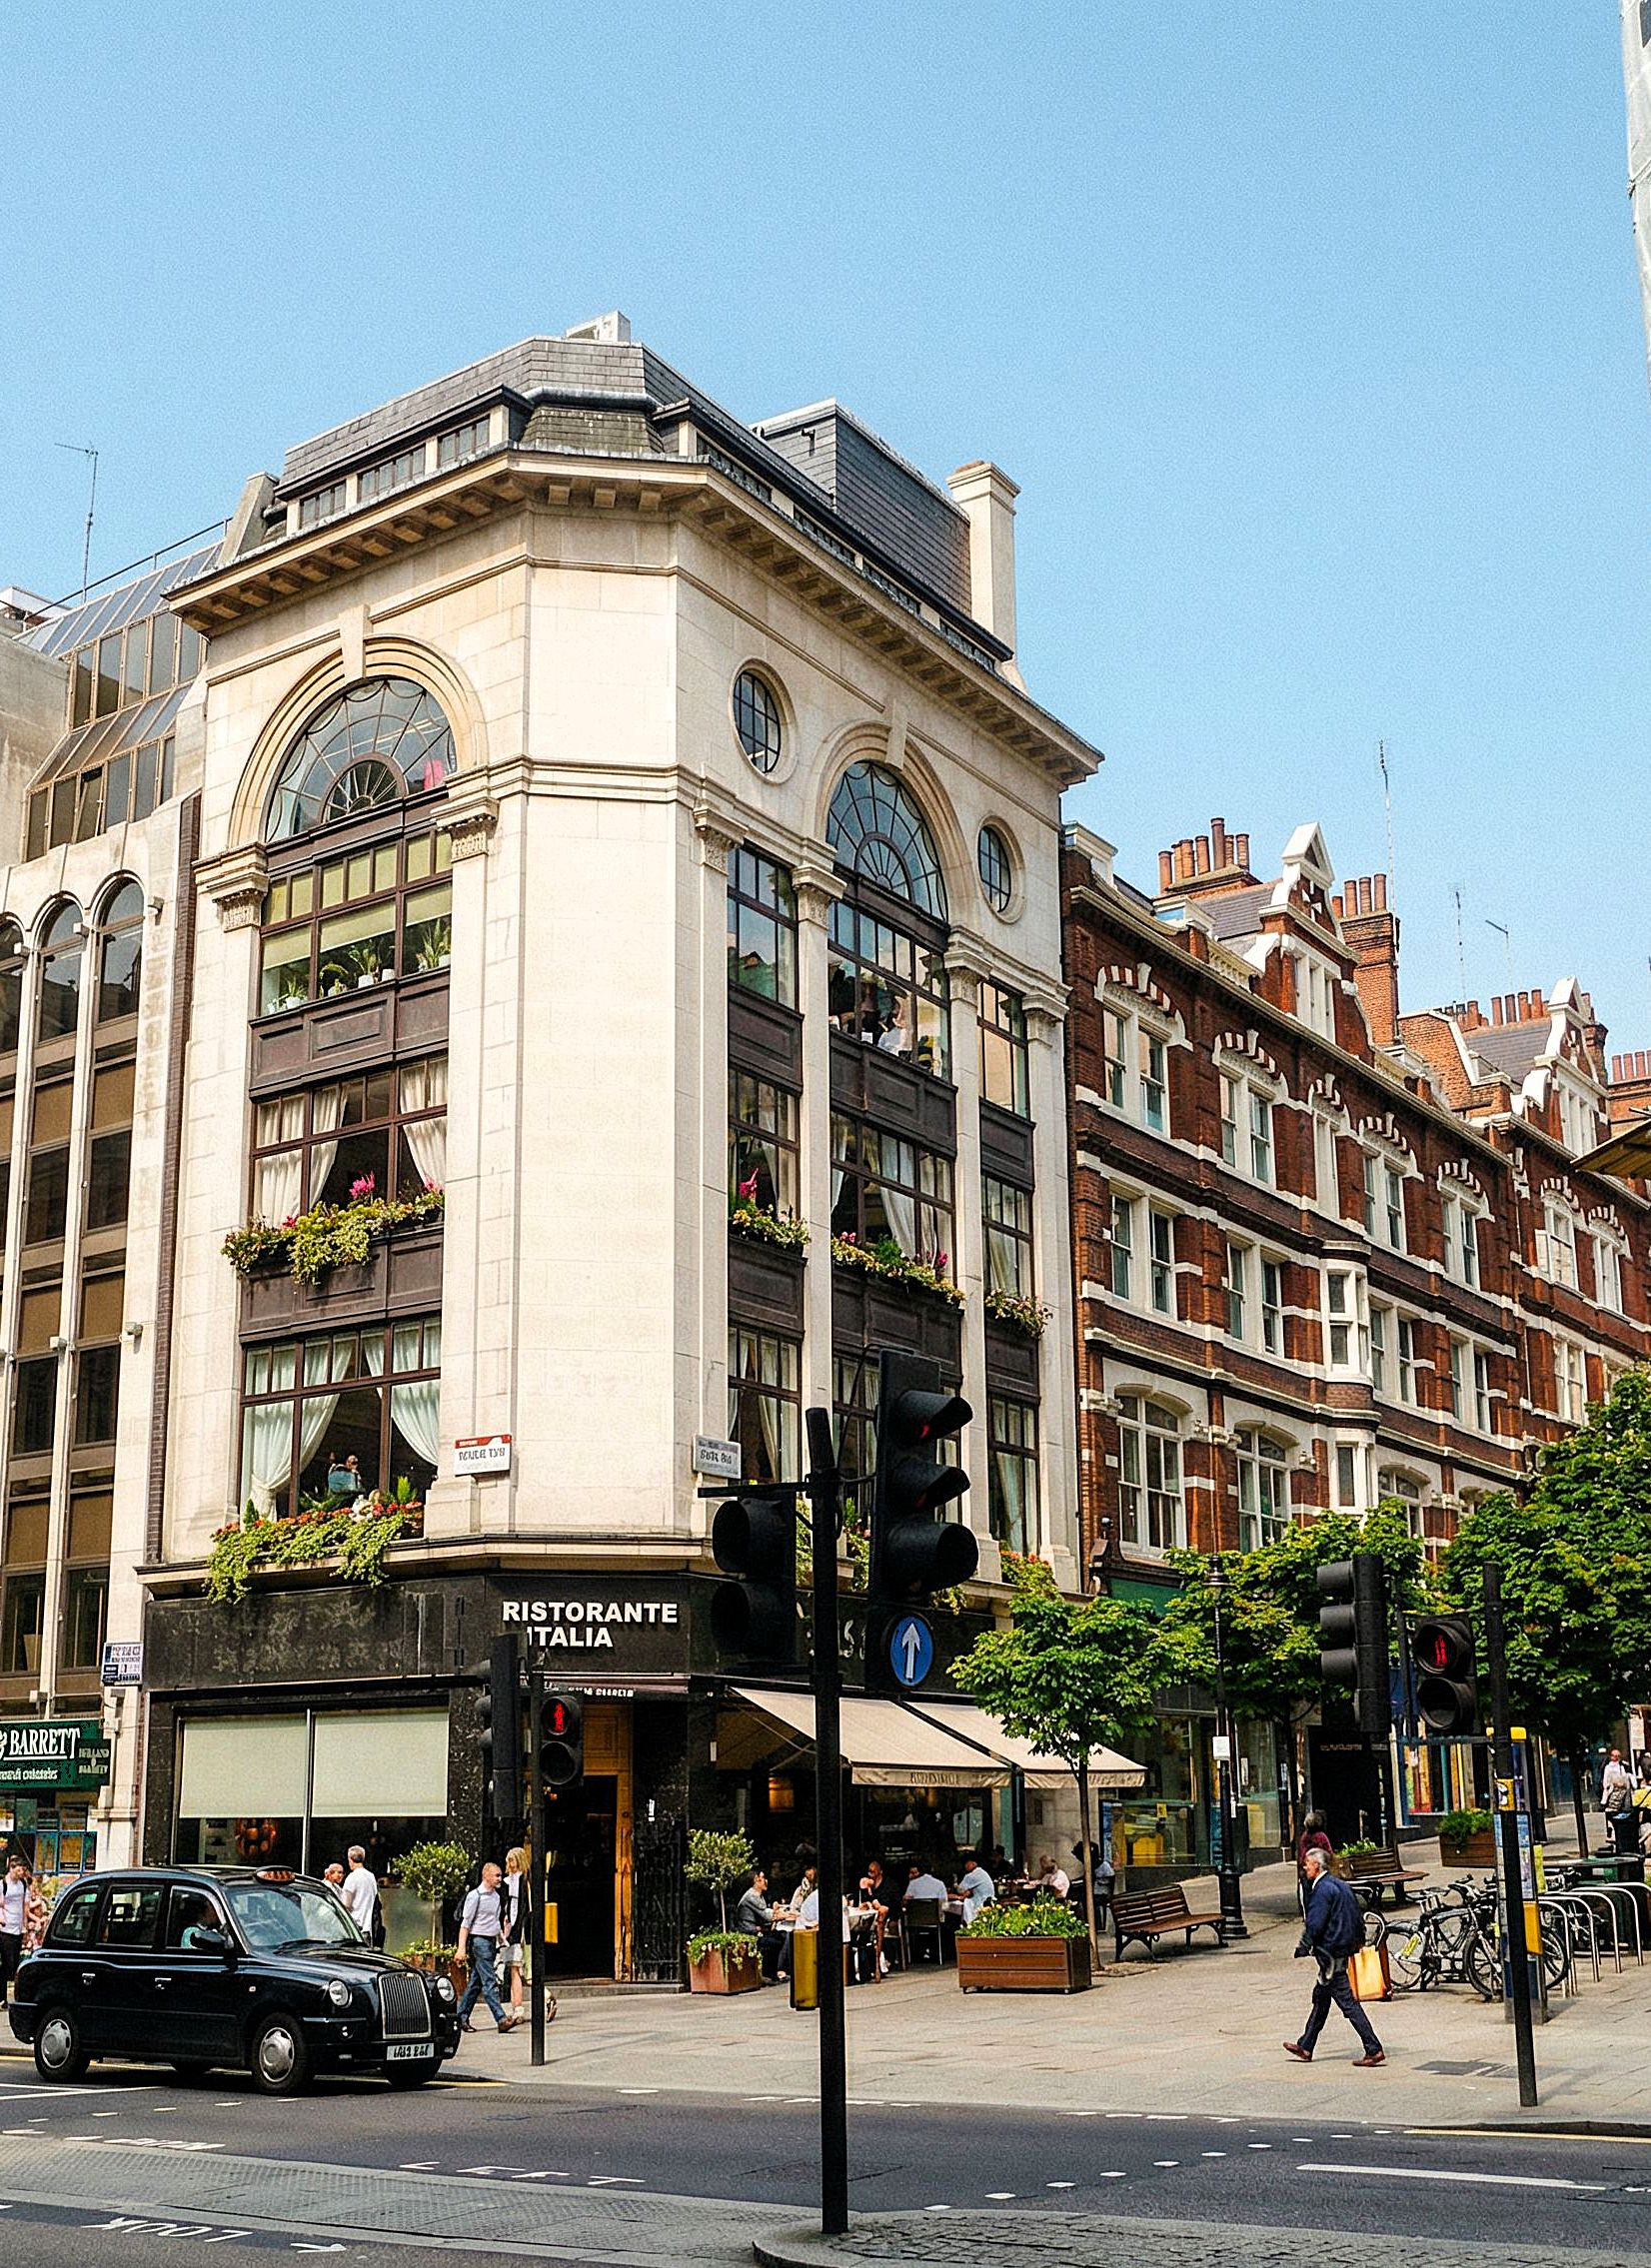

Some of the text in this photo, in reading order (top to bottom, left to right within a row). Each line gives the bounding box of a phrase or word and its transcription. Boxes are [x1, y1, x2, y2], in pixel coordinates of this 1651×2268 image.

[502, 1601, 678, 1624] RISTORANTE
[9, 1727, 81, 1758] BARRETT
[399, 2161, 647, 2186] LEFT
[81, 2217, 254, 2243] LOOK
